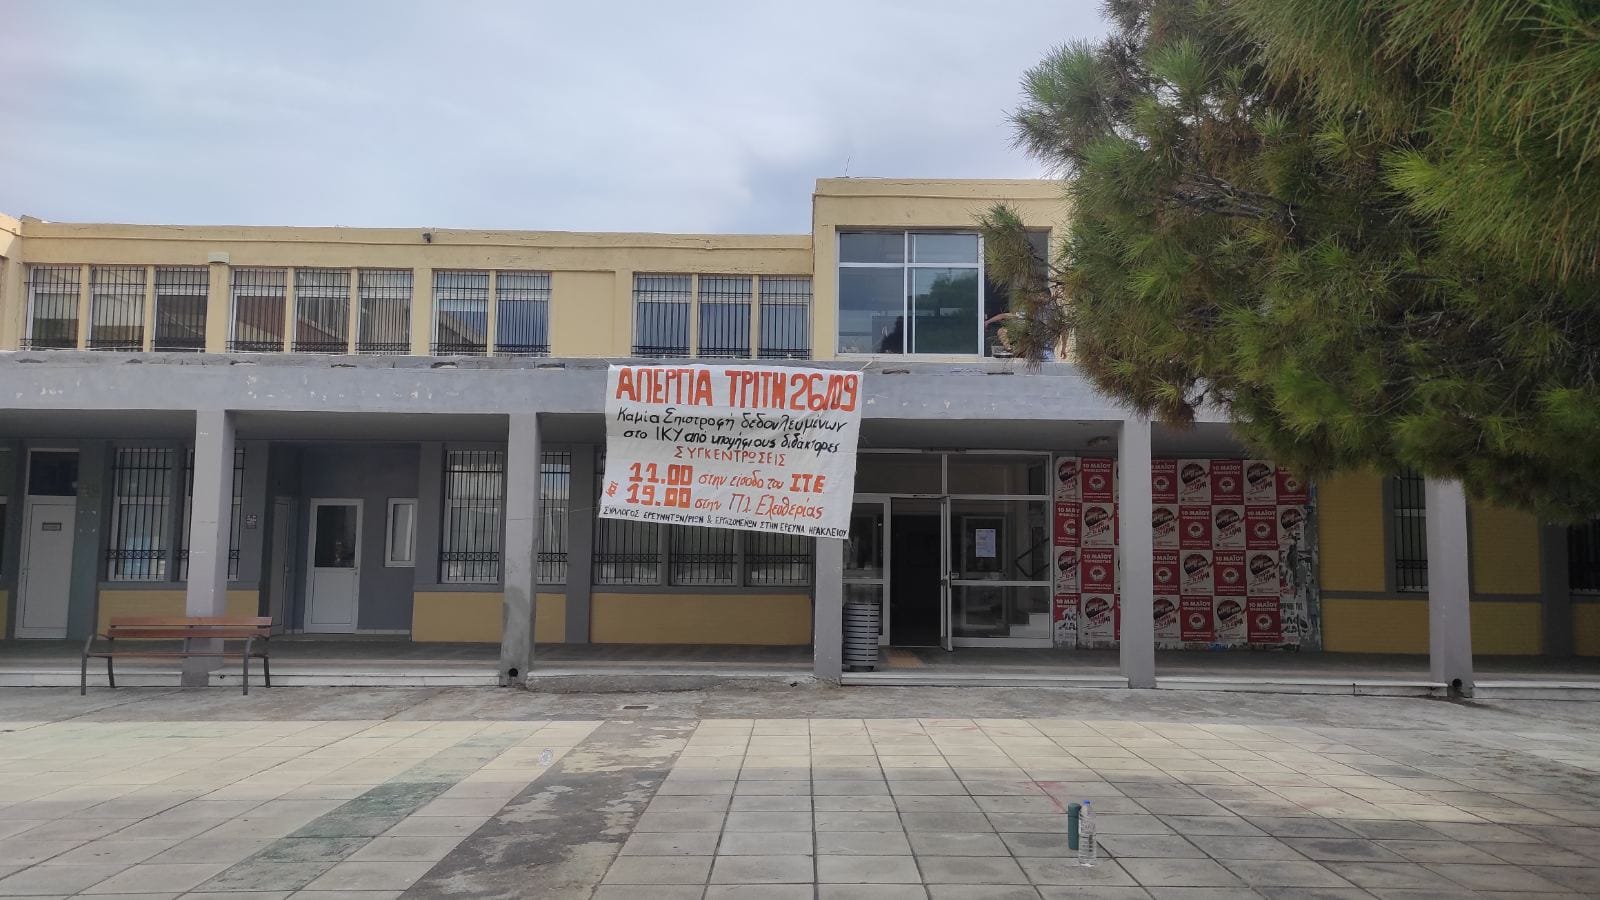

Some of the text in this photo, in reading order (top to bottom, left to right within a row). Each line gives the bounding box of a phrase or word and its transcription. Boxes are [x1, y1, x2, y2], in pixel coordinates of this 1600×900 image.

[616, 368, 858, 412] ΑΠΕΡΓΙΑ ΤΡΙΤΗ 26/09
[617, 407, 660, 424] Καμία
[741, 413, 848, 434] δεδουλευμένων
[624, 430, 648, 439] στο
[656, 426, 684, 442] ΙΚΥ
[684, 431, 707, 443] από
[781, 433, 840, 458] διδάκτορες
[674, 446, 786, 466] ΣΥΓΚΕΝΤΡΩΣΕΙΣ
[605, 480, 618, 498] και
[629, 462, 693, 486] 11.00
[698, 474, 727, 490] στην
[730, 470, 764, 489] είσοδο
[768, 478, 784, 490] του
[624, 483, 692, 508] 19.00
[695, 498, 722, 512] στην
[755, 494, 824, 520] Ελευθερίας
[604, 507, 640, 518] ΣΥΛΛΟΓΟΣ
[706, 514, 713, 524] &
[760, 520, 778, 530] ΣΤΗΝ
[780, 522, 805, 533] ΕΡΕΥΝΑ
[808, 526, 848, 537] ΗΡΑΚΛΕΙΟΥ
